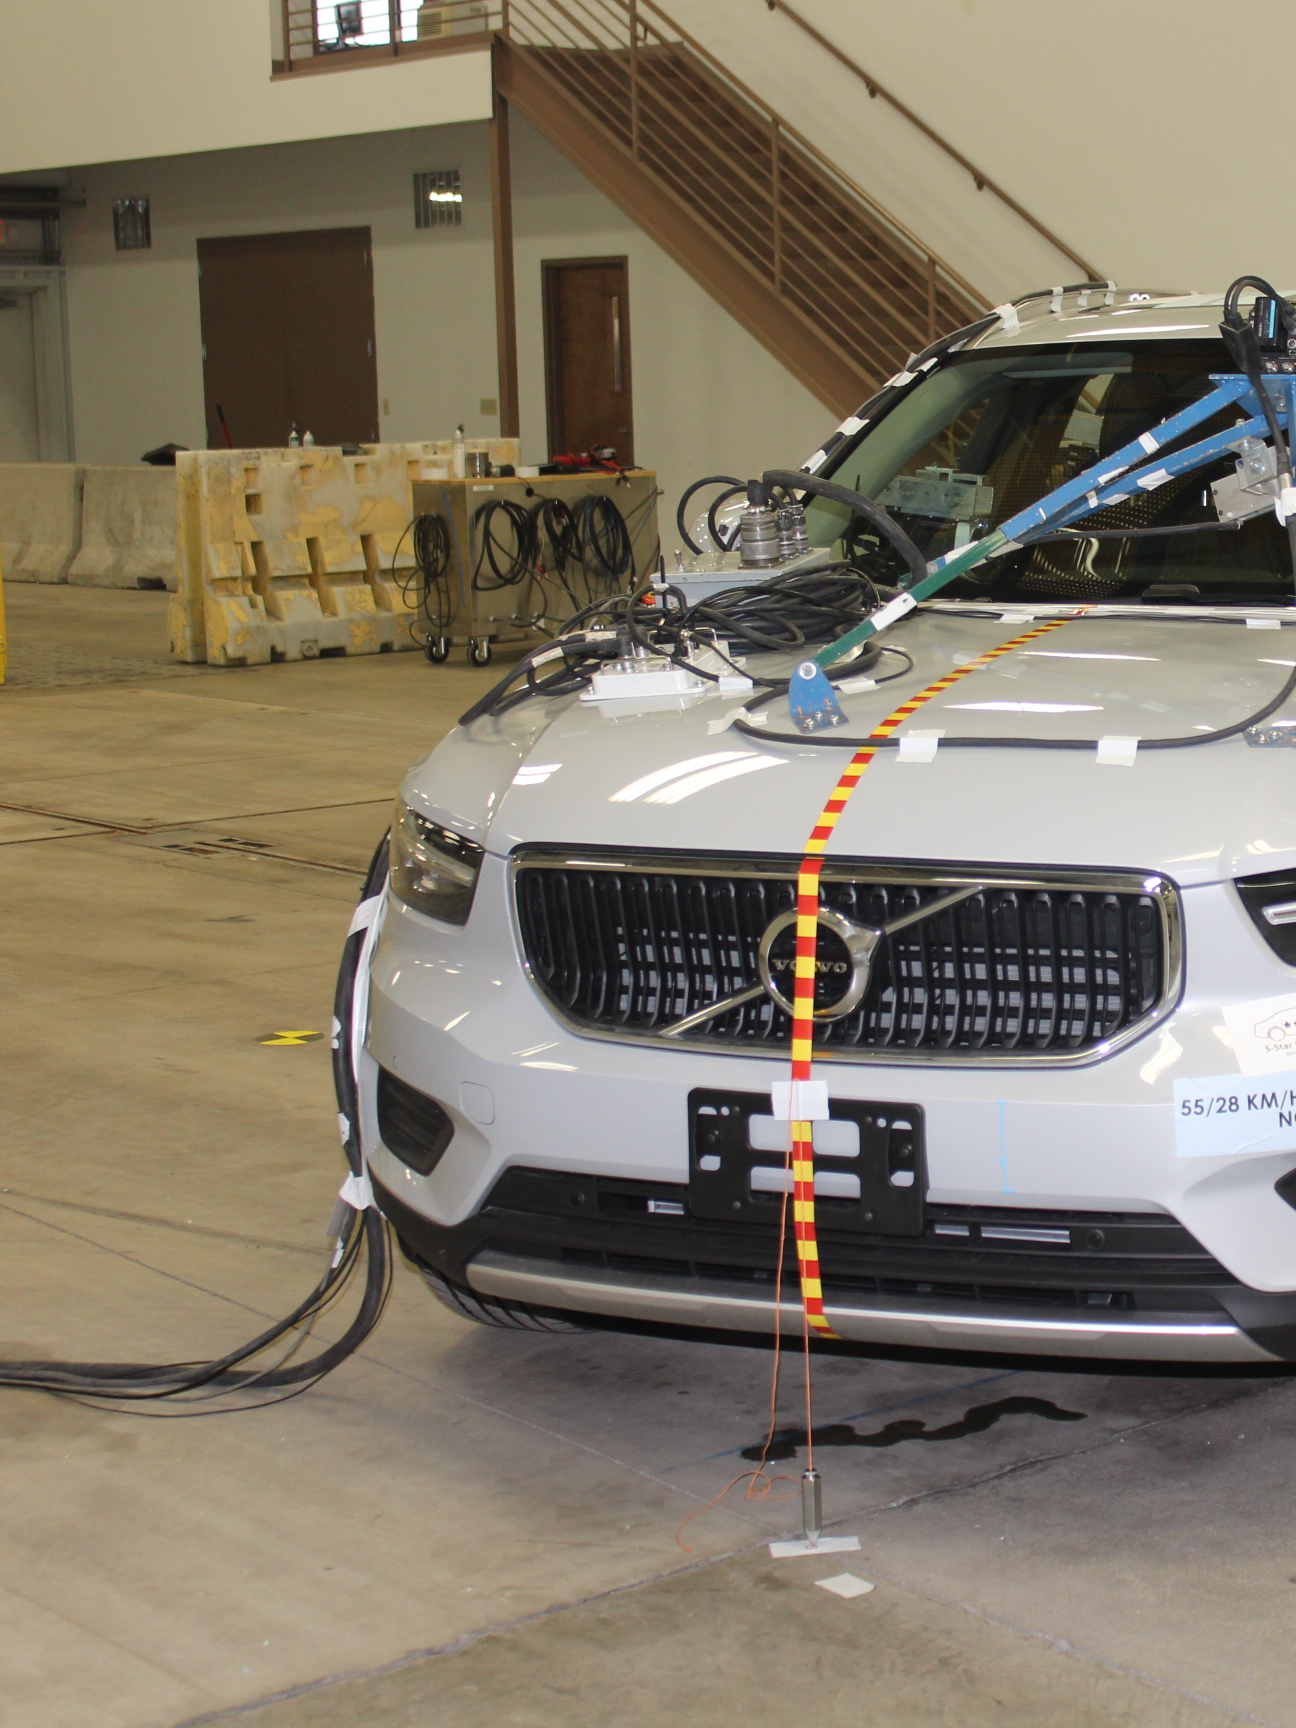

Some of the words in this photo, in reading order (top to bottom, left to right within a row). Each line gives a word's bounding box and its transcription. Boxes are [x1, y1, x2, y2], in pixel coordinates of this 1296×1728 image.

[772, 959, 847, 974] VVO
[1265, 1042, 1292, 1052] 5-Star
[1181, 1095, 1239, 1117] 55/28
